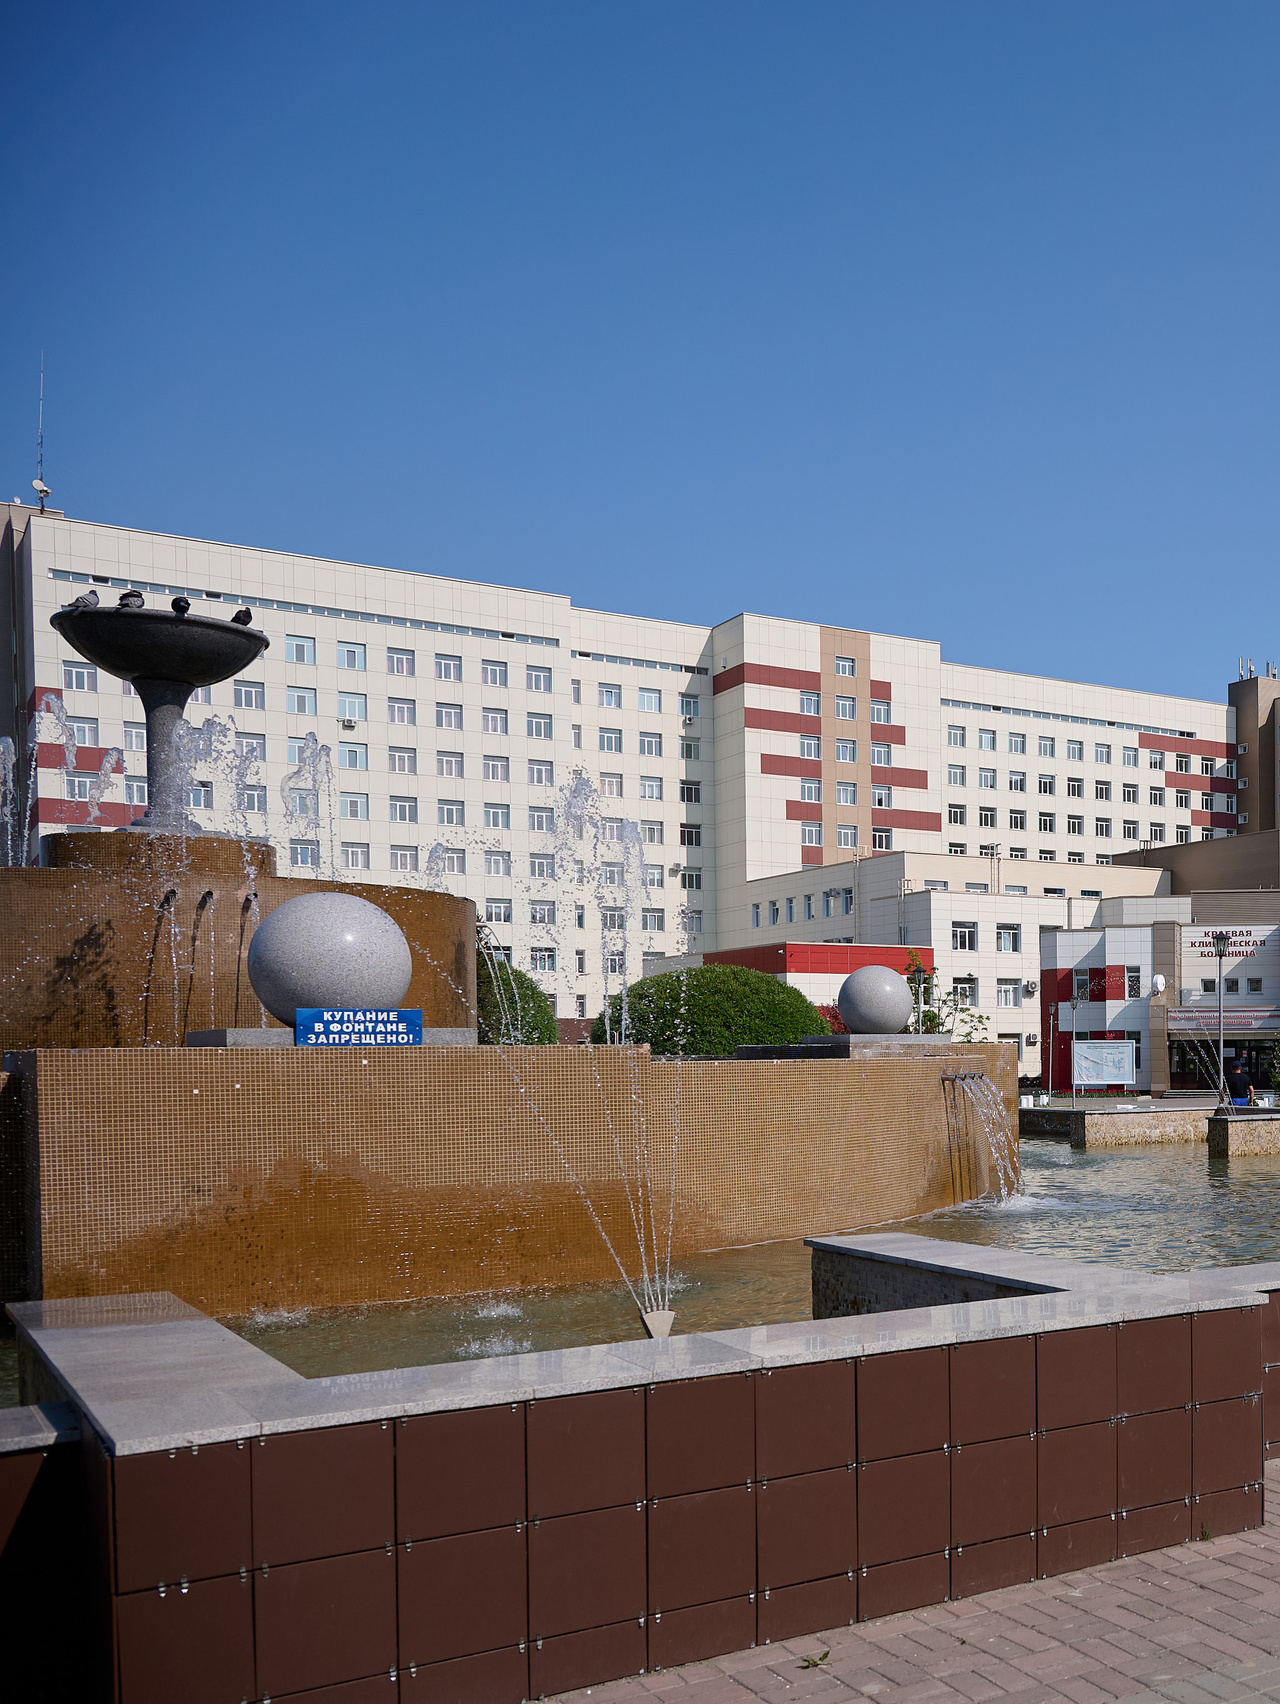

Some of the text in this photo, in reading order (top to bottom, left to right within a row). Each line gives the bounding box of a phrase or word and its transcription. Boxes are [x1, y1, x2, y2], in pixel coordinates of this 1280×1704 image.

[323, 1011, 398, 1021] КУПАНИЕ
[314, 1022, 407, 1032] В ФОНТАНЕ
[307, 1034, 414, 1045] ЗАПРЕЩЕНО!
